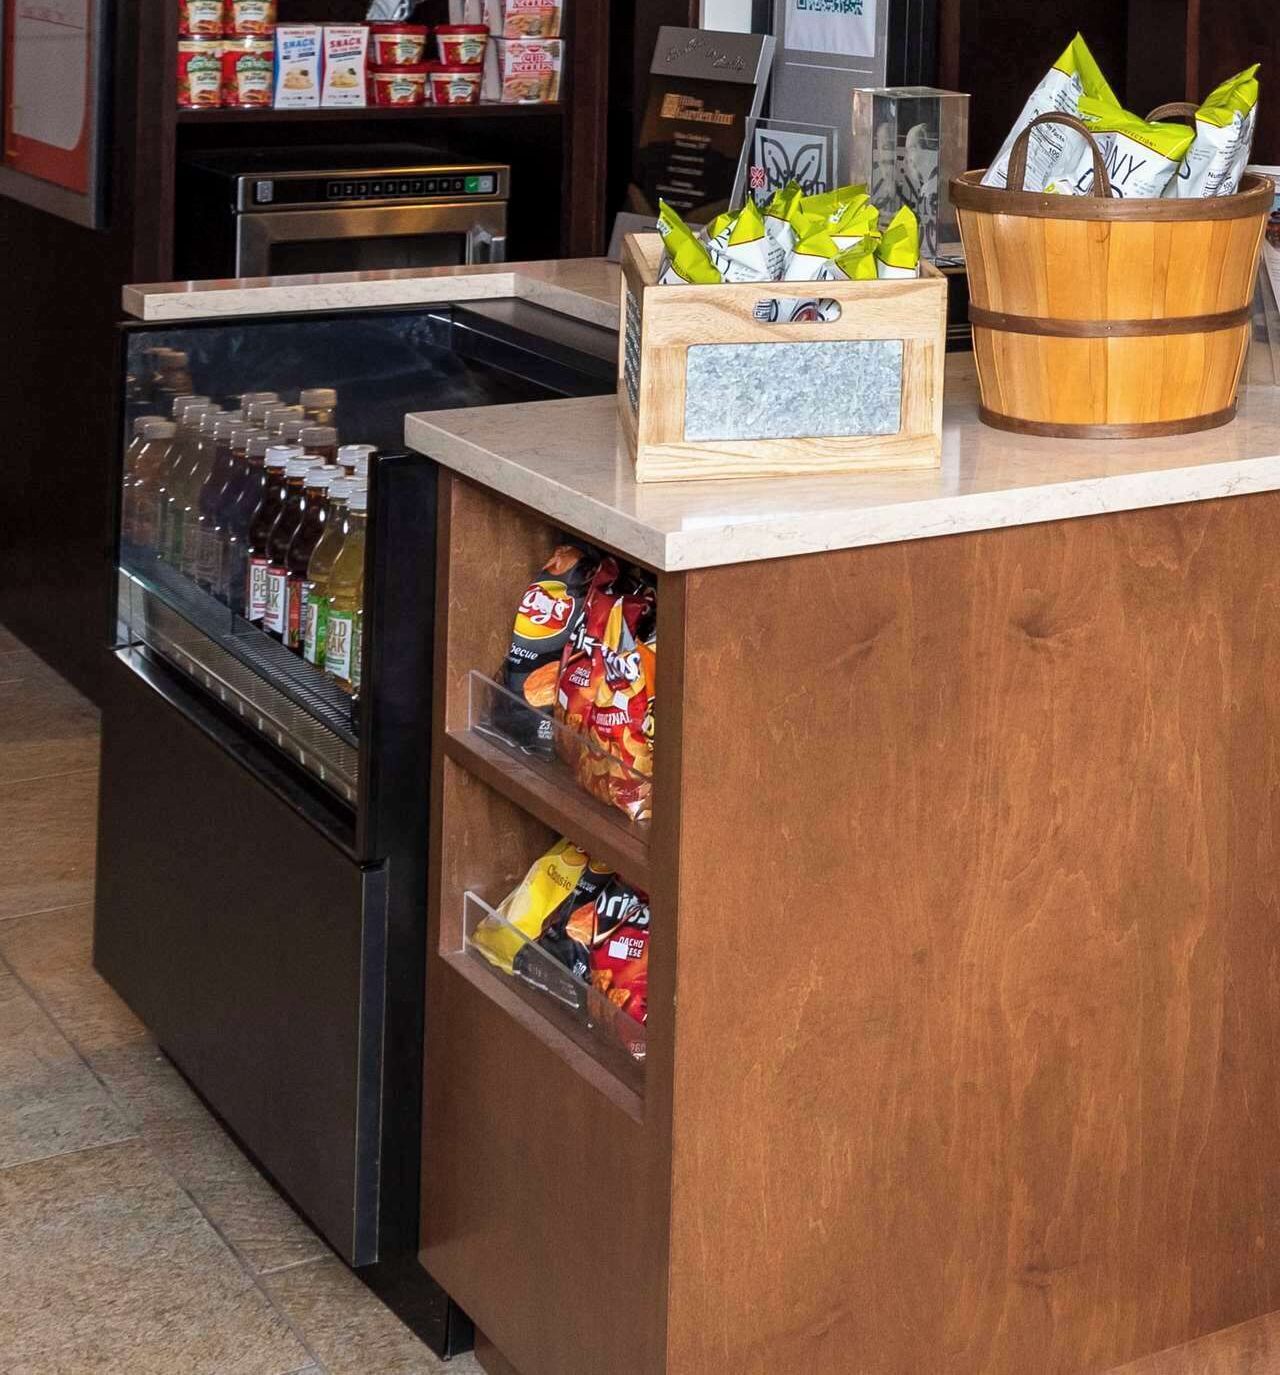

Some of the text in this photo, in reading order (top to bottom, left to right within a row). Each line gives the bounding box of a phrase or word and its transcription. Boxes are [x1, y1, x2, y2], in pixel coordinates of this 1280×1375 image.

[521, 53, 546, 63] CUP
[568, 675, 590, 687] CHEESE
[547, 864, 572, 891] Classic
